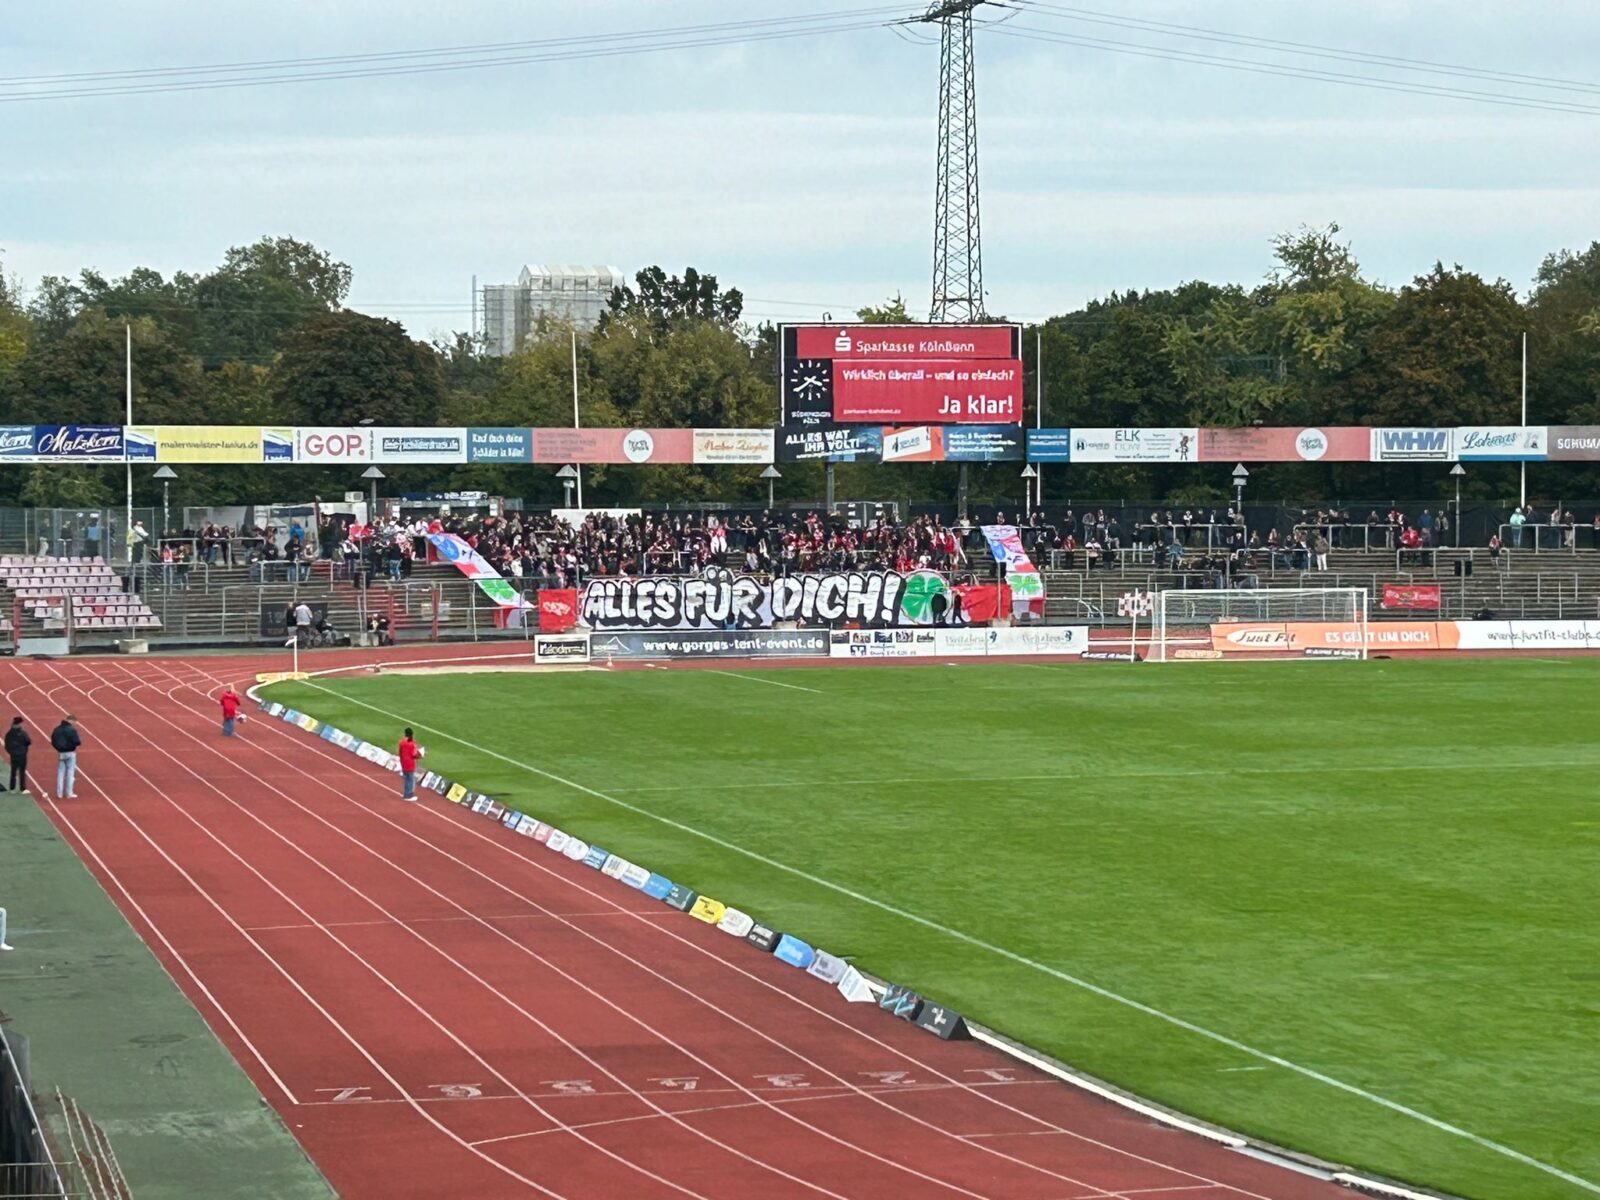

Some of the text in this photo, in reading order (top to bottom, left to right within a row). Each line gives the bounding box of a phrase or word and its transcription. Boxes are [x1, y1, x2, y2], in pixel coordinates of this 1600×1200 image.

[856, 340, 975, 356] Sparkasse KölnBonn
[843, 369, 887, 382] Wirklich
[888, 369, 925, 382] überall
[934, 369, 955, 382] und
[956, 372, 969, 382] so
[971, 369, 1014, 382] einfach?
[938, 394, 1014, 415] Ja klar!
[785, 430, 851, 446] ALLES WAT
[1115, 430, 1140, 441] ELK
[1384, 431, 1447, 451] WHM
[305, 435, 365, 457] GOP.
[804, 438, 860, 453] IHR VOLT!
[584, 565, 905, 629] ALLES FÜR DICH!
[1236, 631, 1297, 644] Just Fit
[1324, 631, 1341, 643] ES
[1378, 631, 1399, 643] UM
[1400, 630, 1431, 643] DICH
[643, 637, 824, 655] www.gorges-tent-event.de
